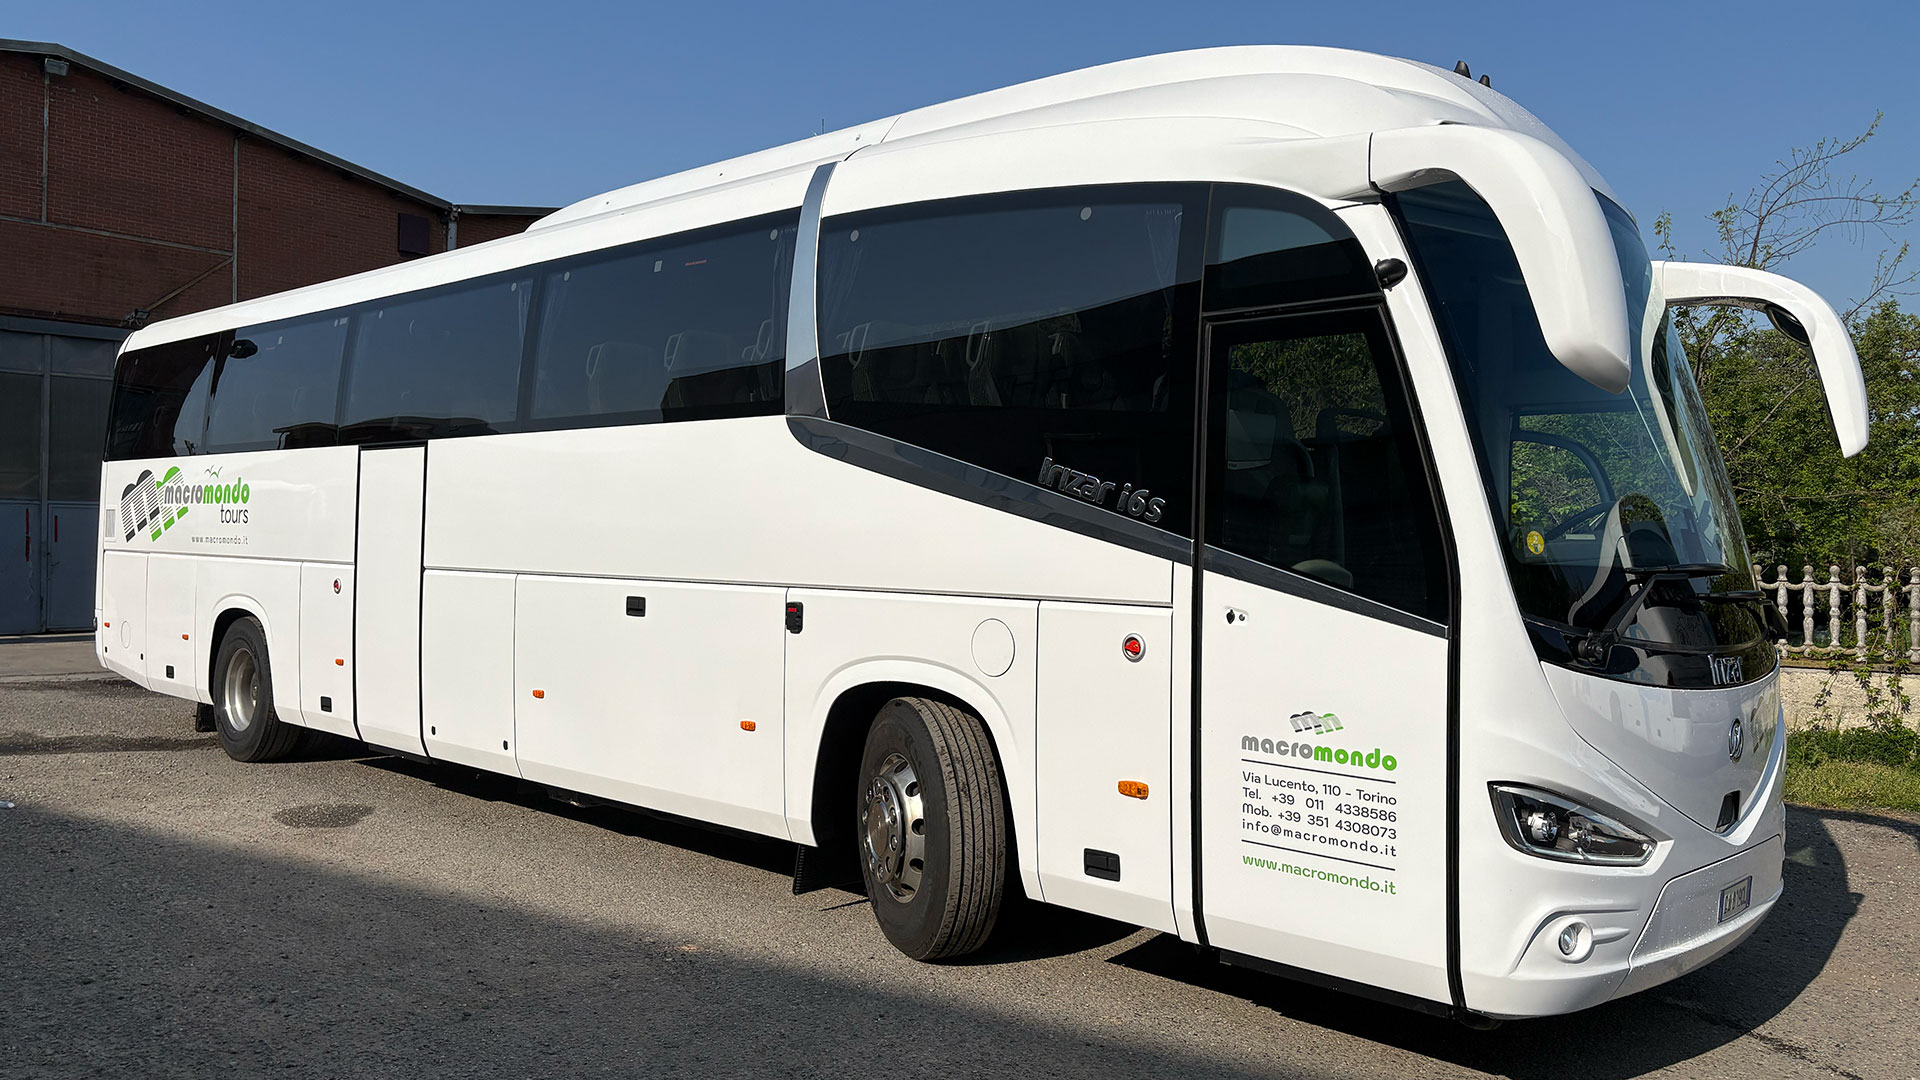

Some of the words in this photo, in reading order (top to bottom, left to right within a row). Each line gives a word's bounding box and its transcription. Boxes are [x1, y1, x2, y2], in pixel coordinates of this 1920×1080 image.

[164, 477, 250, 504] macromondo
[1116, 483, 1166, 523] i6s
[220, 504, 249, 524] tours
[191, 535, 249, 545] www.macromondo.it
[1241, 735, 1398, 771] macromondo
[1242, 771, 1261, 784] Via
[1264, 774, 1319, 795] Lucento,
[1322, 784, 1341, 796] 110
[1356, 789, 1397, 806] Torino
[1242, 787, 1262, 800] Tel.
[1272, 793, 1295, 805] +39
[1305, 799, 1325, 811] 011
[1335, 803, 1397, 822] 4338586
[1242, 803, 1272, 818] Mob.
[1278, 811, 1301, 823] +39
[1307, 814, 1329, 828] 351
[1335, 820, 1397, 840] 4308073
[1242, 819, 1397, 857] info@macromondo.it
[1242, 855, 1397, 895] www.macromondo.it
